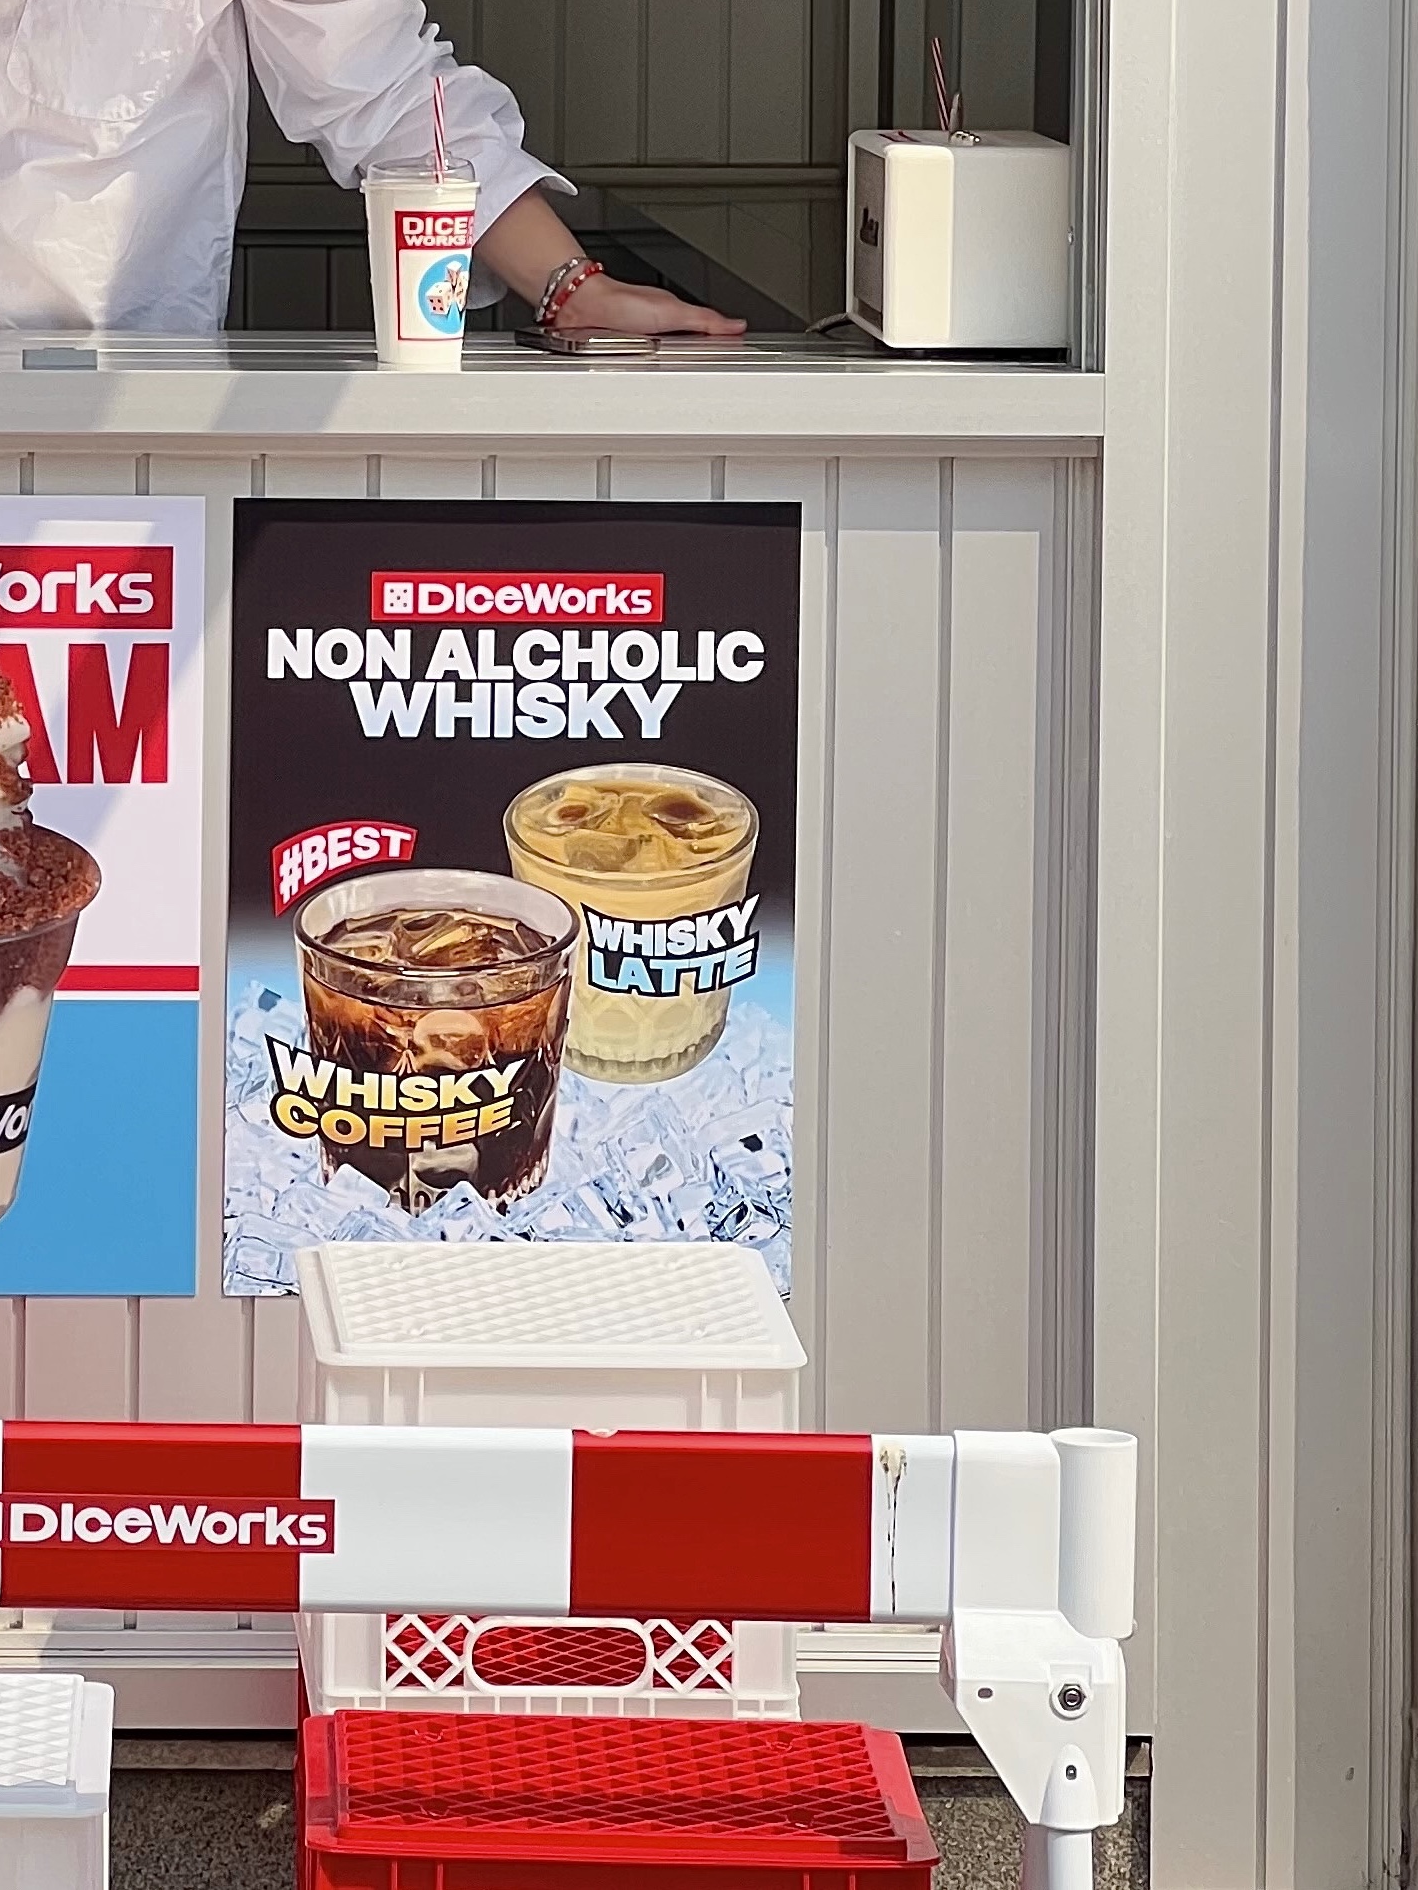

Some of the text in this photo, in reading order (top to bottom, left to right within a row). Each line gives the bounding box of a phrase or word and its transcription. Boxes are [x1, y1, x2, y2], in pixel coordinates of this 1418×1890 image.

[402, 215, 468, 236] DICE
[267, 628, 766, 682] NON ALCHOLIC
[349, 681, 682, 739] WHISKY
[277, 826, 413, 904] #BEST
[585, 903, 752, 958] WHISKY
[589, 942, 755, 993] LATTE
[270, 1040, 523, 1113] WHISKY
[272, 1093, 514, 1151] COFFEE
